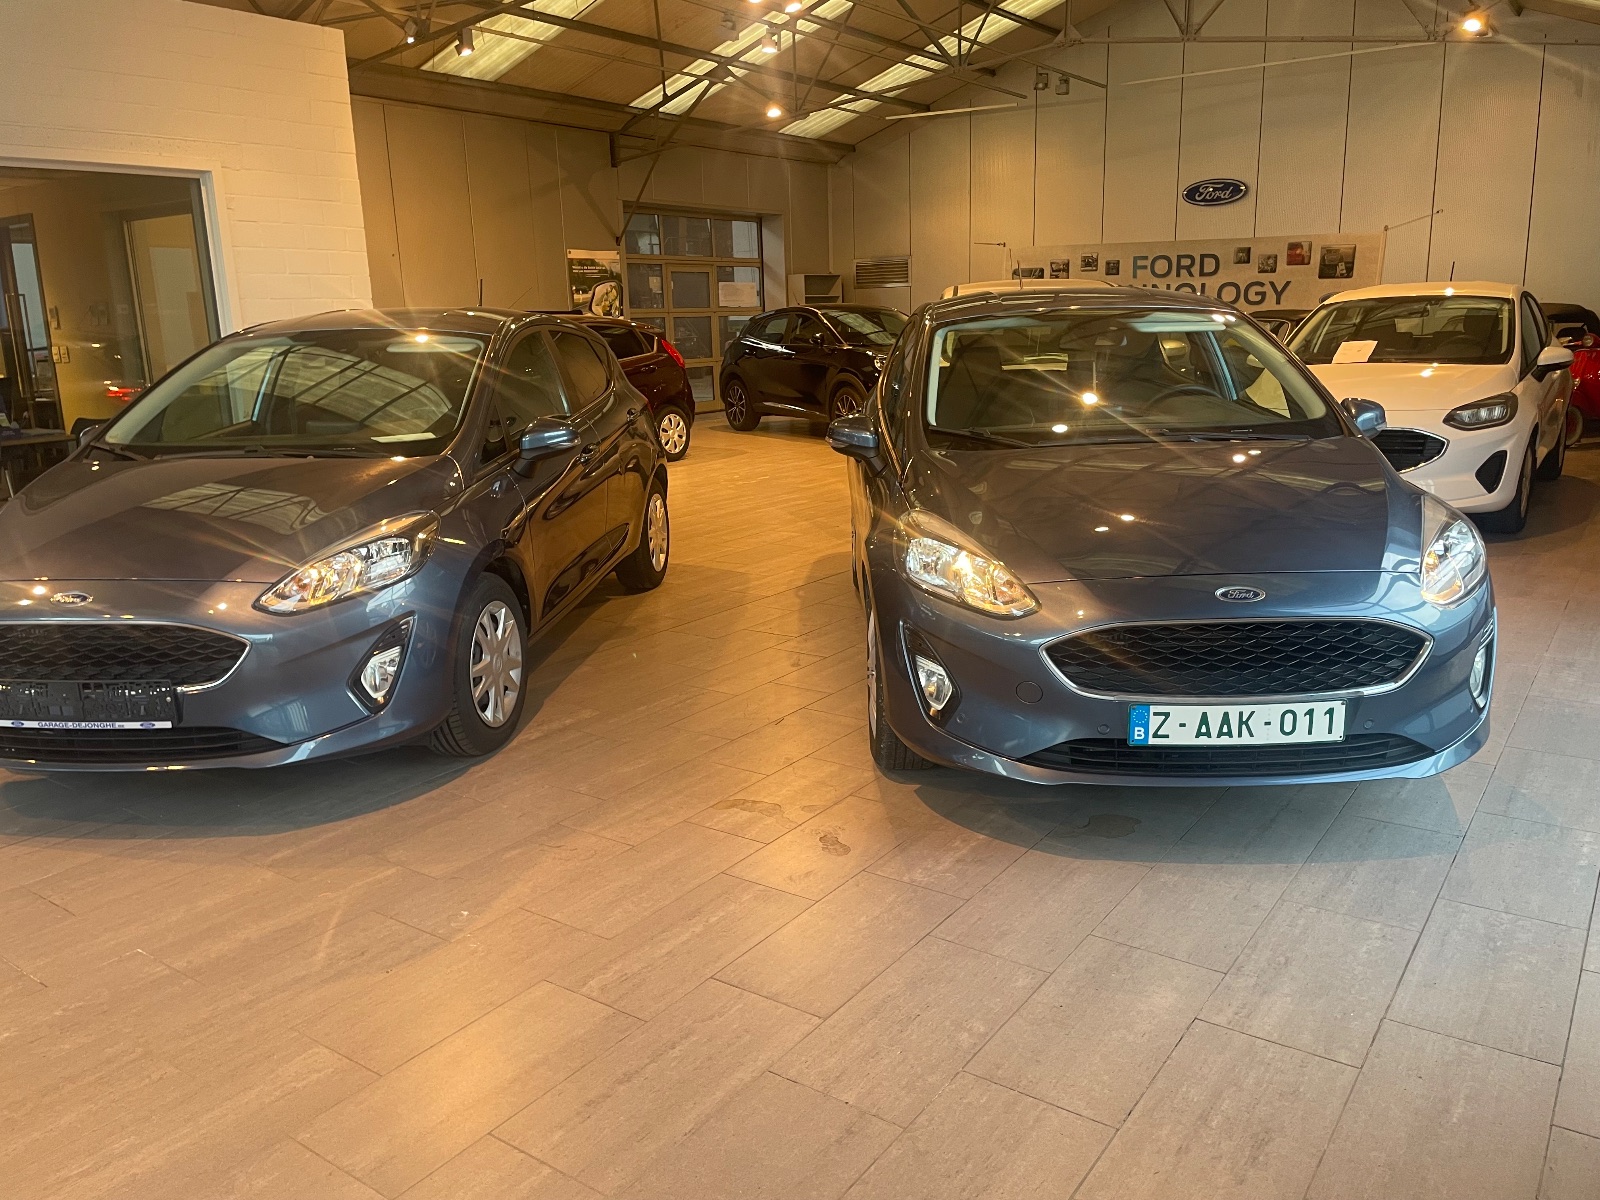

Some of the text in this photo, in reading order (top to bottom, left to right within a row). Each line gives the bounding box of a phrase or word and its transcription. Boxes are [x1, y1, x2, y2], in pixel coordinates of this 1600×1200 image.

[1195, 183, 1234, 201] Ford
[1132, 253, 1220, 279] FORD
[1134, 727, 1145, 740] B
[1151, 707, 1336, 739] Z-AAK-011
